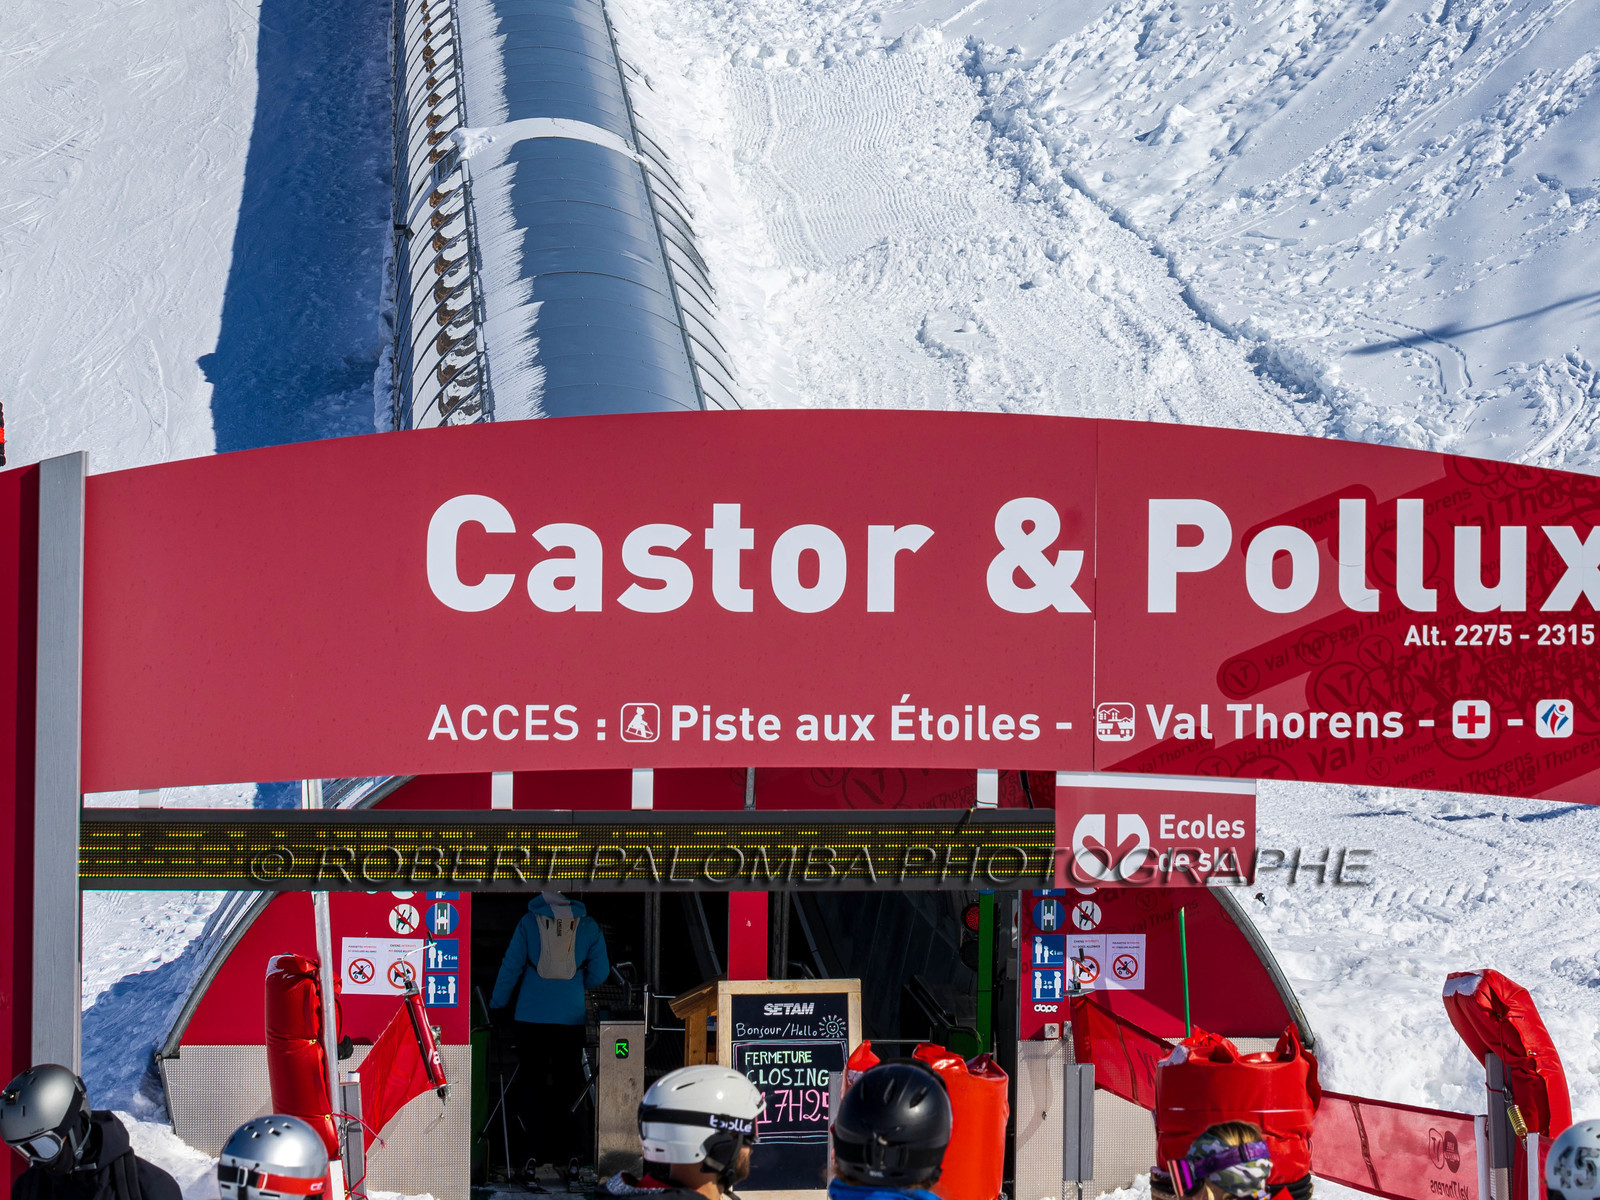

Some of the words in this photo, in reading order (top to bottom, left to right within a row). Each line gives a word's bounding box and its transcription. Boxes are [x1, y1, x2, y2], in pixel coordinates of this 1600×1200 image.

[427, 495, 934, 613] Castor
[987, 497, 1091, 613] &
[1148, 499, 1600, 613] Pollux
[1404, 625, 1446, 645] Alt.
[1455, 625, 1512, 645] 2275
[1538, 624, 1595, 645] 2315
[428, 704, 579, 741] ACCES
[672, 704, 781, 741] Piste
[796, 714, 875, 741] aux
[891, 694, 1040, 741] Étoiles
[1146, 704, 1212, 740] Val
[1227, 704, 1404, 740] Thorens
[1542, 736, 1600, 770] Thoren
[1160, 814, 1245, 839] Ecoles
[1158, 850, 1192, 873] de
[1199, 849, 1236, 873] ski
[763, 1002, 815, 1016] SETAM
[745, 1051, 812, 1066] FERMETURE
[746, 1068, 829, 1087] CLOSING
